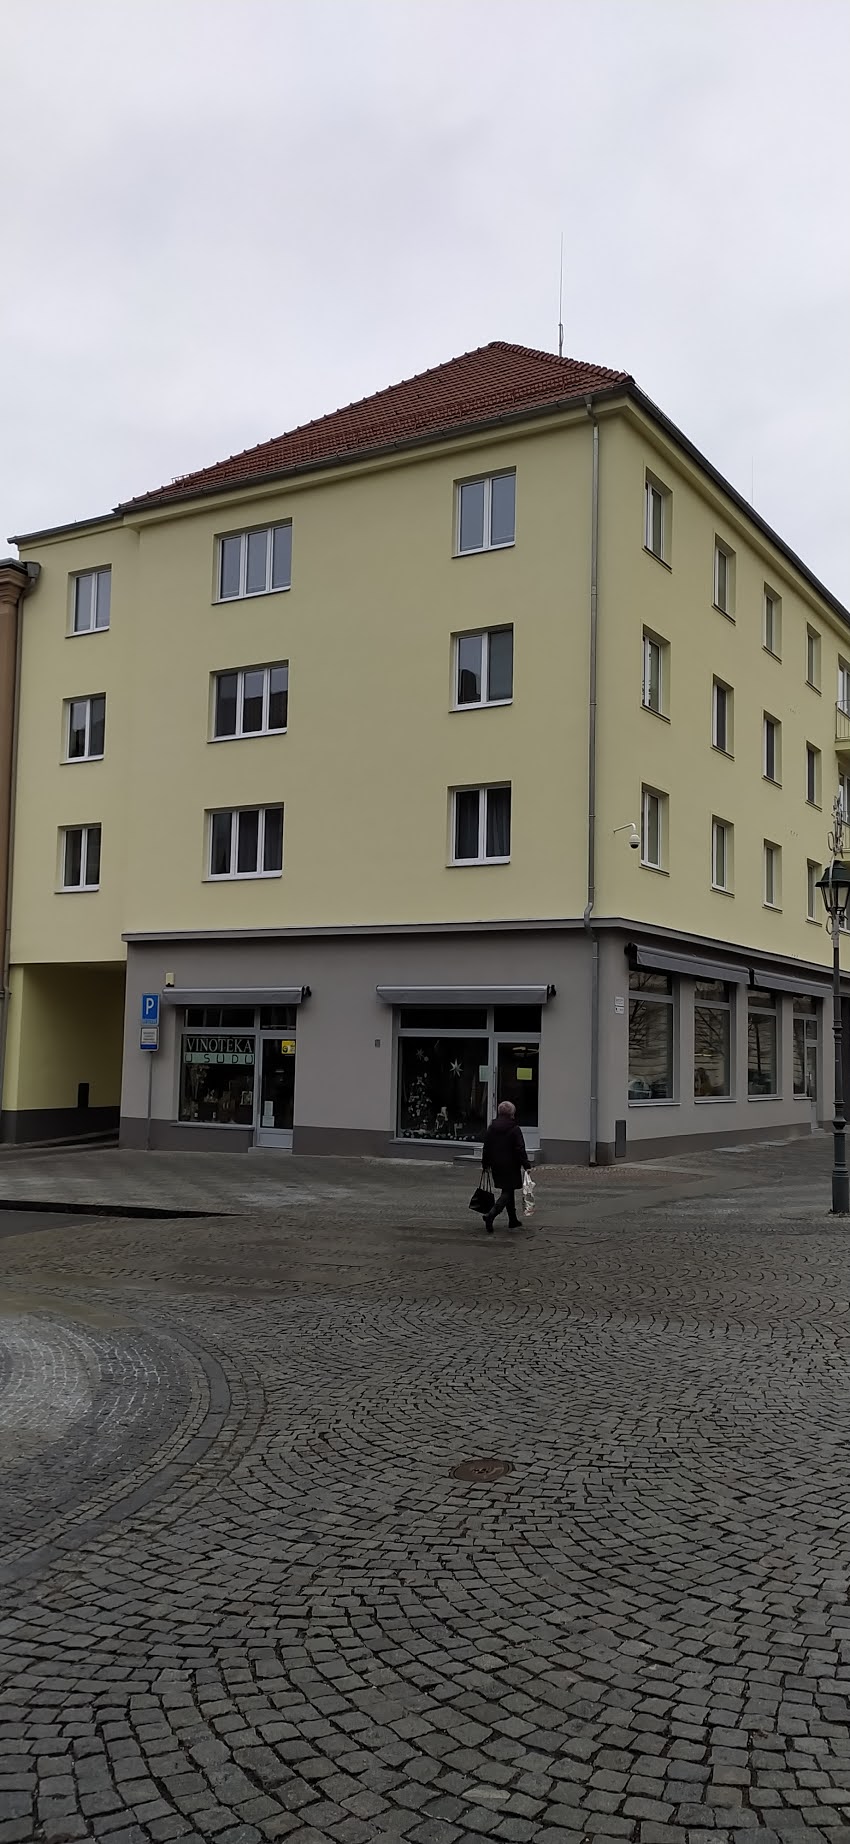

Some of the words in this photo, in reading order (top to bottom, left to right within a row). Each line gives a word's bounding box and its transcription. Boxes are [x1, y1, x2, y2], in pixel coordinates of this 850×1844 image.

[146, 997, 154, 1015] P
[187, 1038, 253, 1053] VINOTEKA
[185, 1053, 193, 1063] U
[204, 1053, 254, 1064] SUDU
